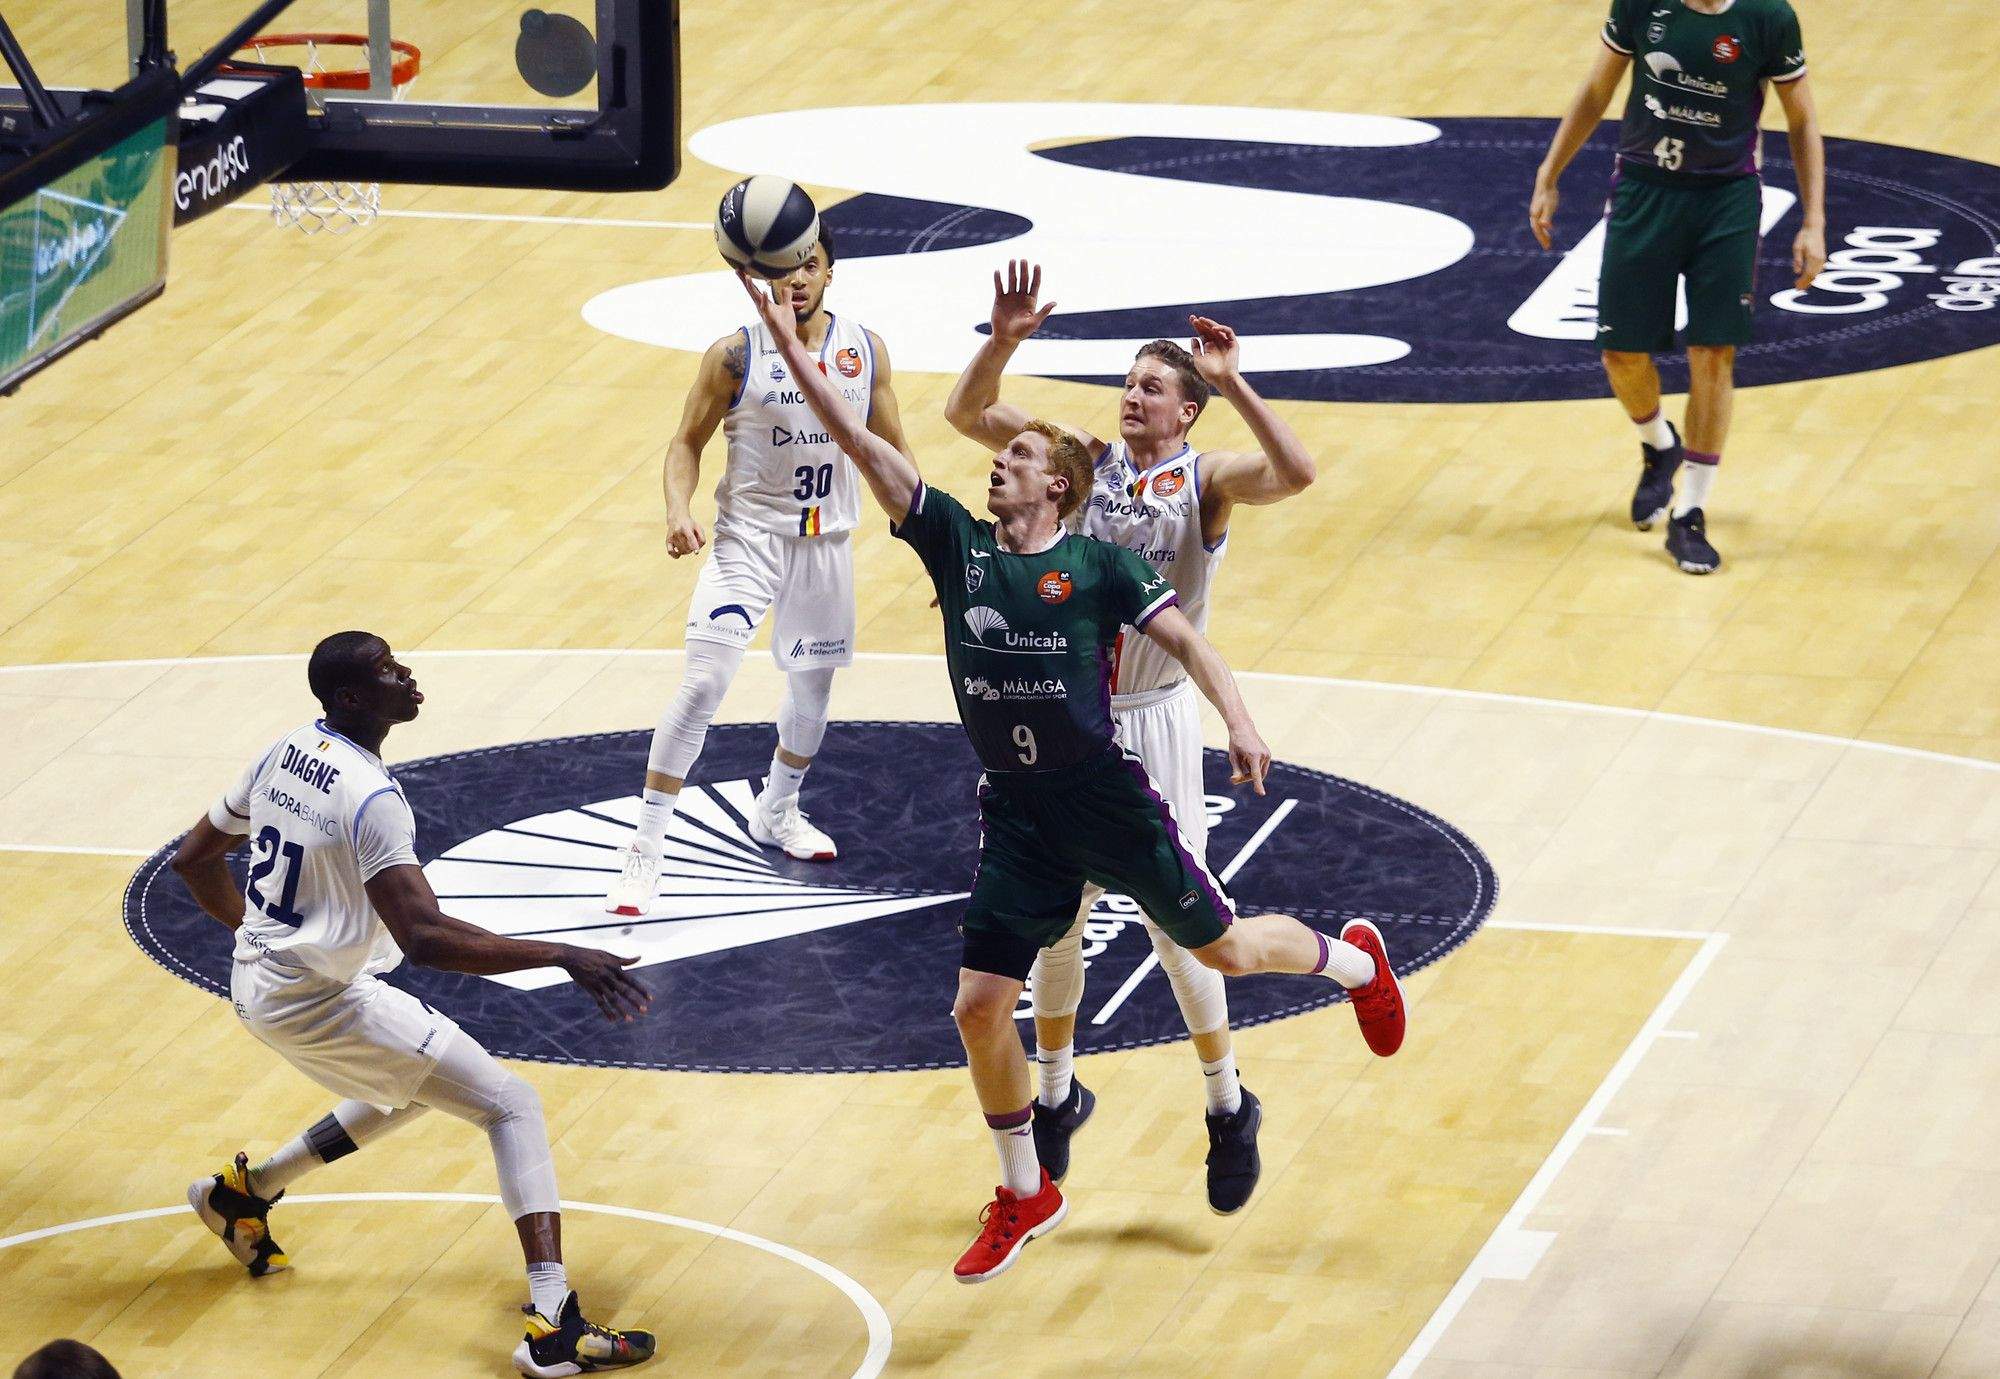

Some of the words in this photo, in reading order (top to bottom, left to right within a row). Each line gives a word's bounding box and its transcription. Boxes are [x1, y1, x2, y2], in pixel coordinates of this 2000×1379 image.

[174, 135, 249, 210] endesa
[1653, 136, 1685, 171] 43
[1769, 226, 1943, 314] Copa
[793, 463, 833, 501] 30
[809, 646, 845, 656] telecom
[811, 639, 845, 648] andorra
[1005, 631, 1067, 649] Unicaja
[1003, 677, 1067, 694] MÁLAGA
[1012, 724, 1038, 765] 9
[281, 744, 340, 795] DIAGNE
[268, 788, 337, 837] MORABANC
[247, 825, 305, 928] 21
